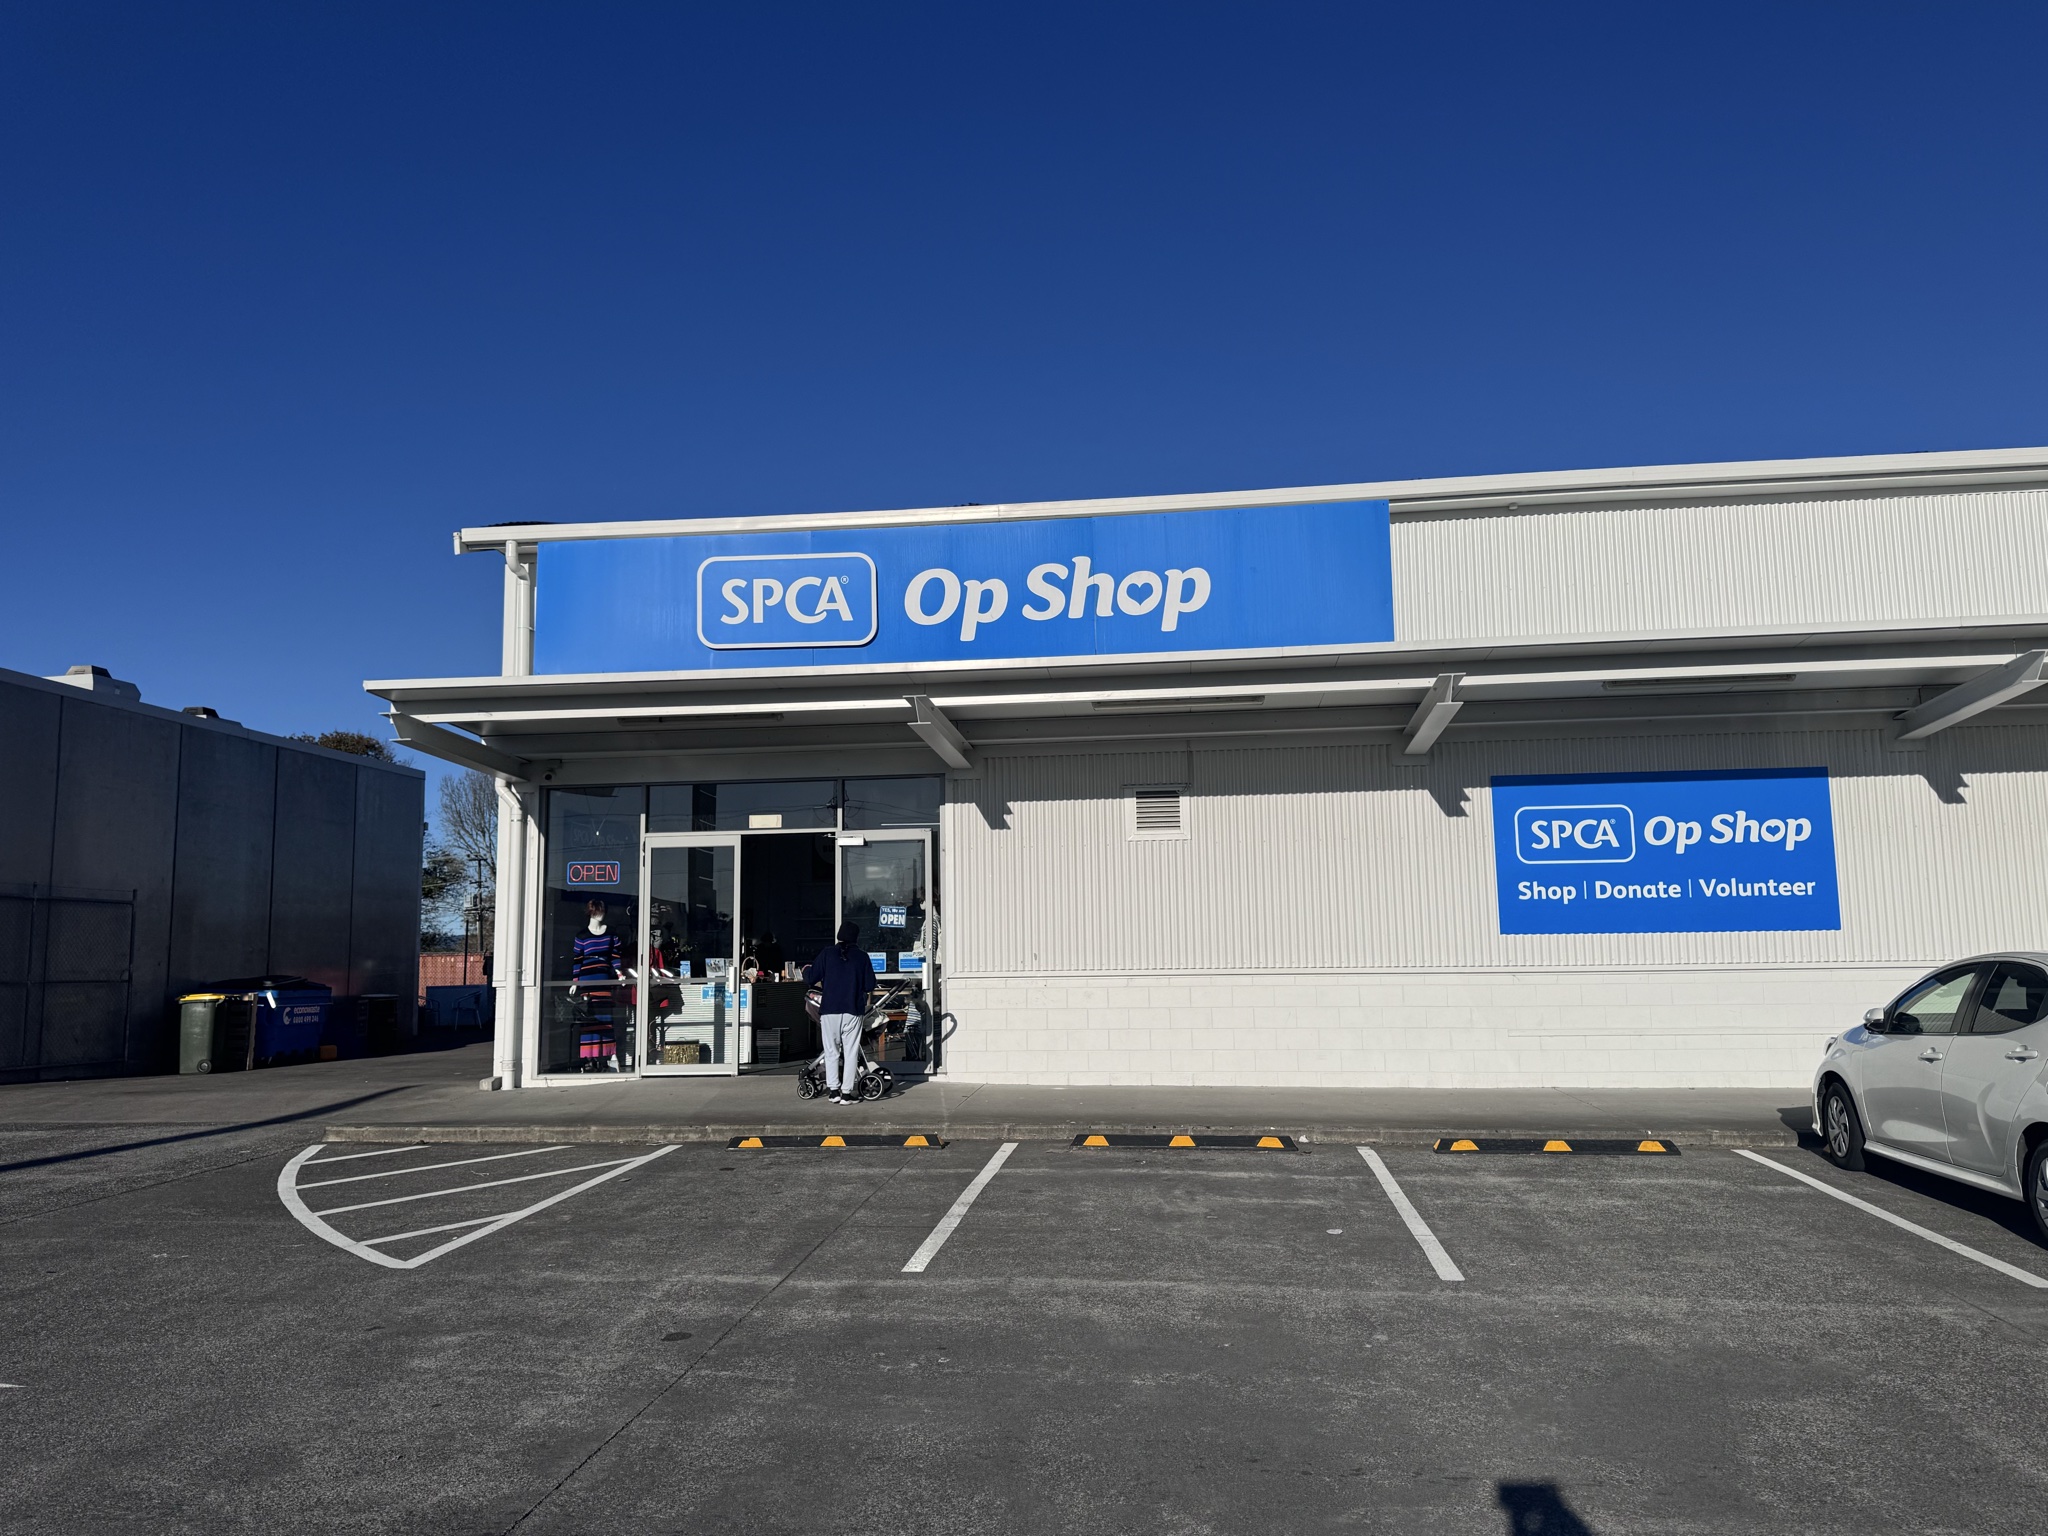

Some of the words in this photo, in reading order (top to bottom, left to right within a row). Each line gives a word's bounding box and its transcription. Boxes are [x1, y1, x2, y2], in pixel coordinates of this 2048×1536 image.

[904, 568, 1008, 642] Op
[1022, 556, 1211, 632] Shop
[1644, 816, 1702, 854] Op
[1709, 811, 1812, 851] Shop
[569, 864, 618, 882] OPEN
[1518, 881, 1576, 904] Shop
[1595, 880, 1681, 899] Donate
[1699, 878, 1816, 897] Volunteer
[880, 913, 905, 925] OPEN
